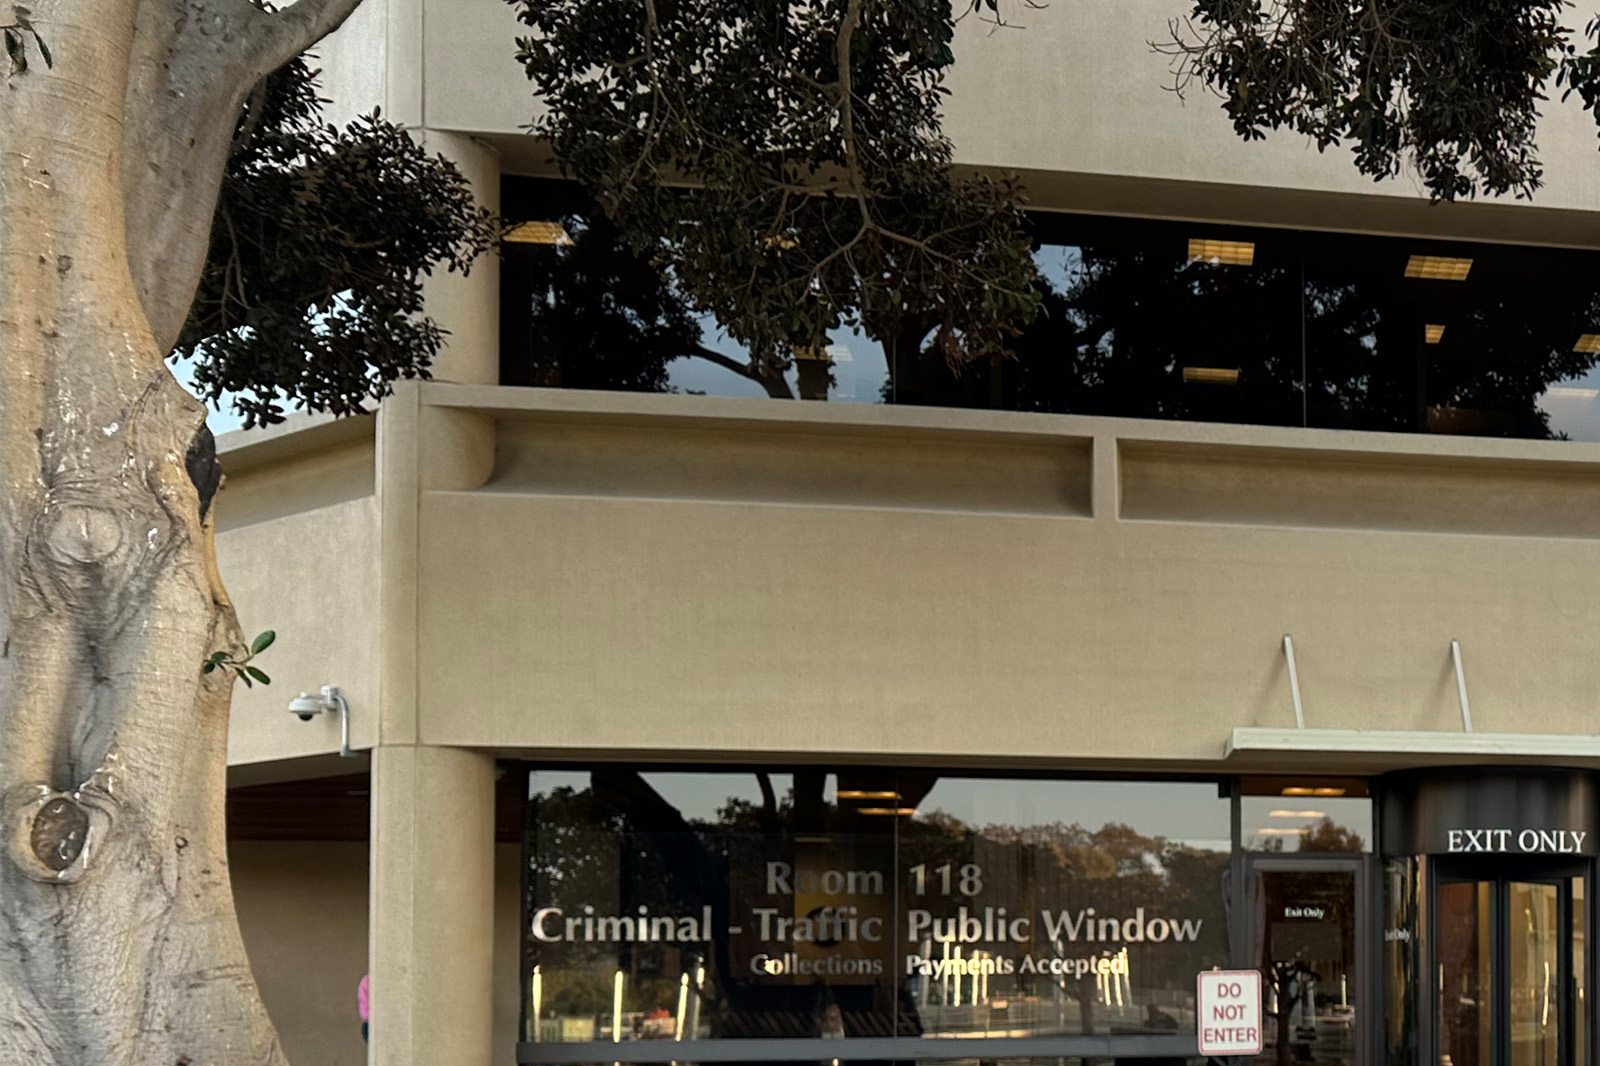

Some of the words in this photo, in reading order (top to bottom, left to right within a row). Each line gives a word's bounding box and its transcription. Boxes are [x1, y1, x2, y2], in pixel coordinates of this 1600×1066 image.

[1447, 829, 1511, 853] EXIT
[1518, 829, 1587, 854] ONLY
[765, 861, 883, 896] Room
[908, 863, 983, 897] 118
[531, 905, 712, 943] Criminal
[728, 926, 742, 934] -
[752, 906, 883, 942] Traffic
[908, 906, 1031, 943] Public
[1041, 906, 1202, 943] Window
[750, 953, 883, 976] Collections
[906, 954, 1014, 980] Payments
[1019, 952, 1126, 979] Accepted
[1217, 982, 1242, 999] DO
[1213, 1004, 1246, 1021] NOT
[1203, 1027, 1258, 1044] ENTER
